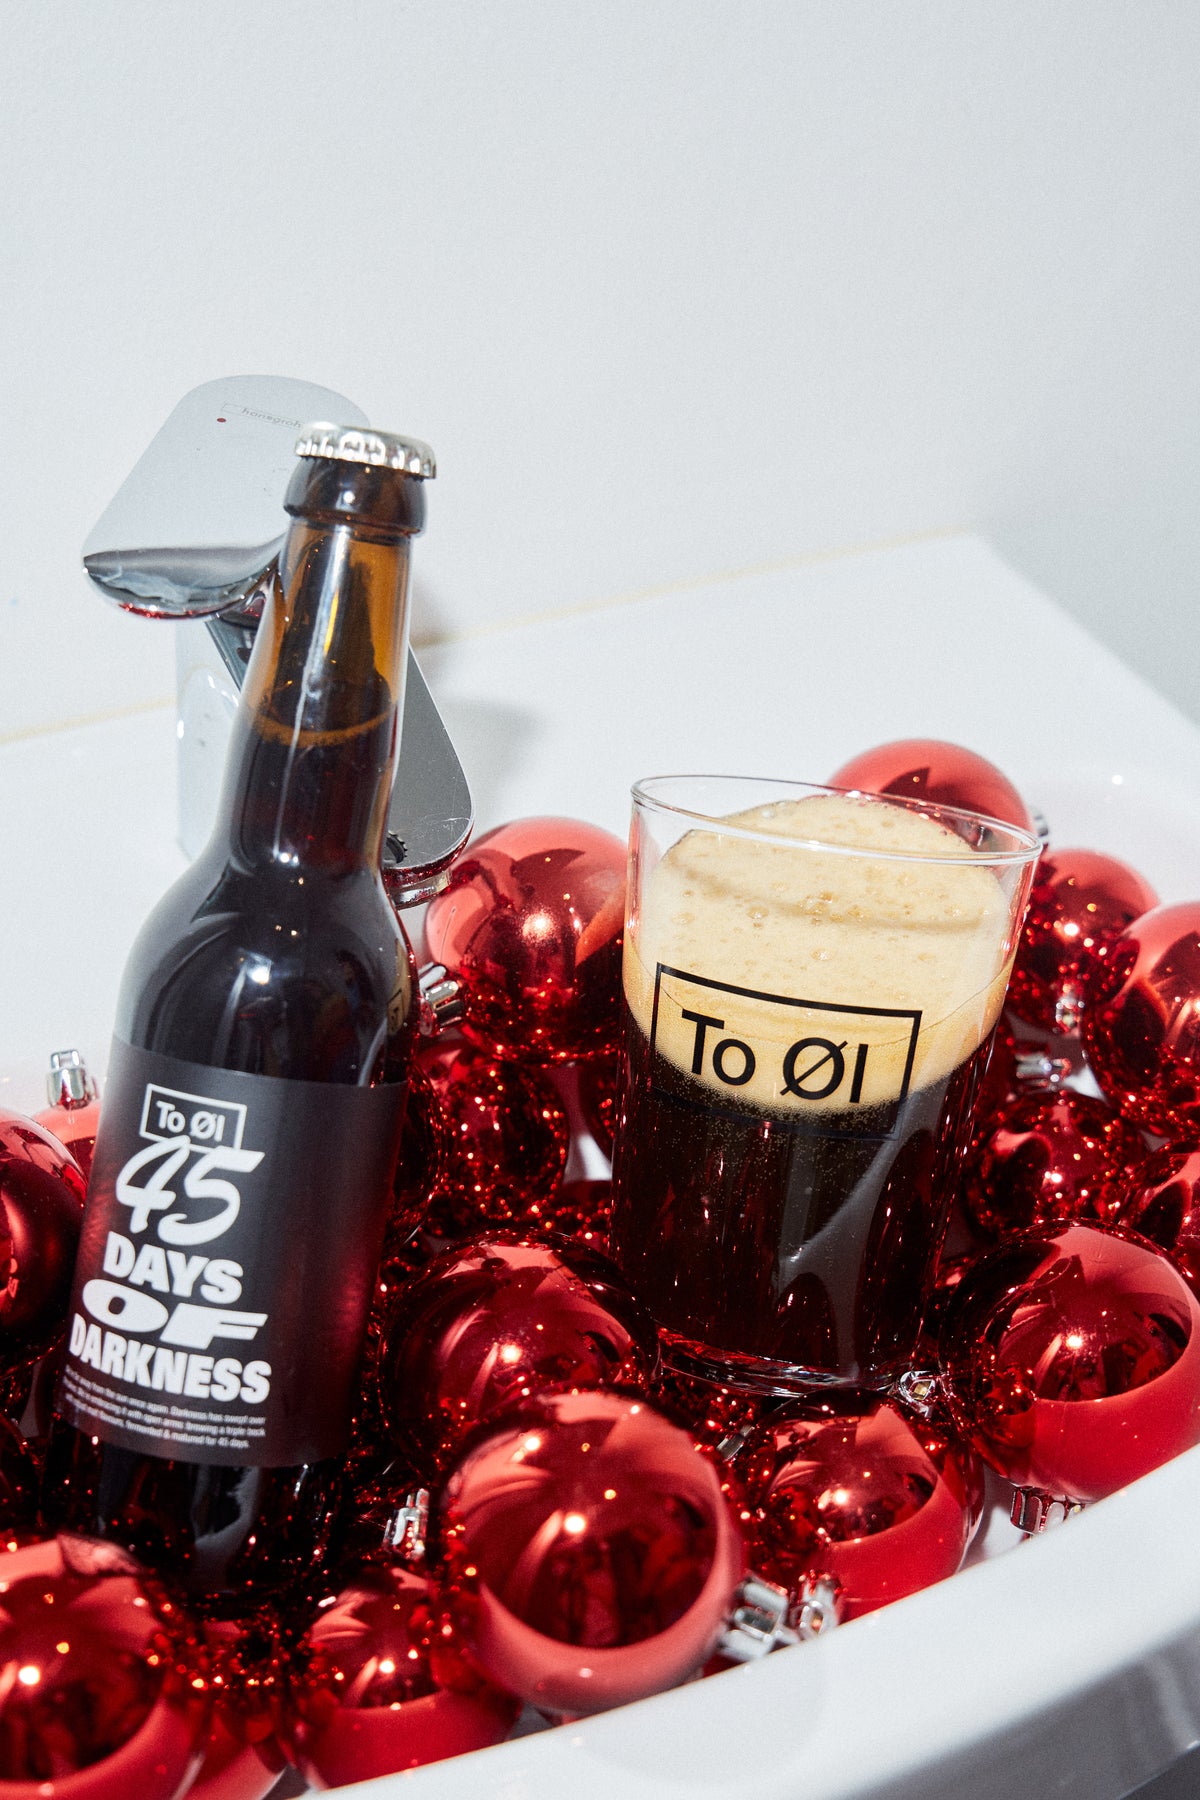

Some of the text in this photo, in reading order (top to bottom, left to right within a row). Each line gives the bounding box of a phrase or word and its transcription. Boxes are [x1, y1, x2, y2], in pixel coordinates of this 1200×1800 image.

[241, 407, 302, 428] hansgroh
[681, 1008, 756, 1086] To
[156, 1100, 186, 1133] To
[116, 1135, 265, 1246] 45
[103, 1231, 244, 1304] DAYS
[82, 1278, 269, 1350] OF
[68, 1312, 273, 1405] DARKNESS
